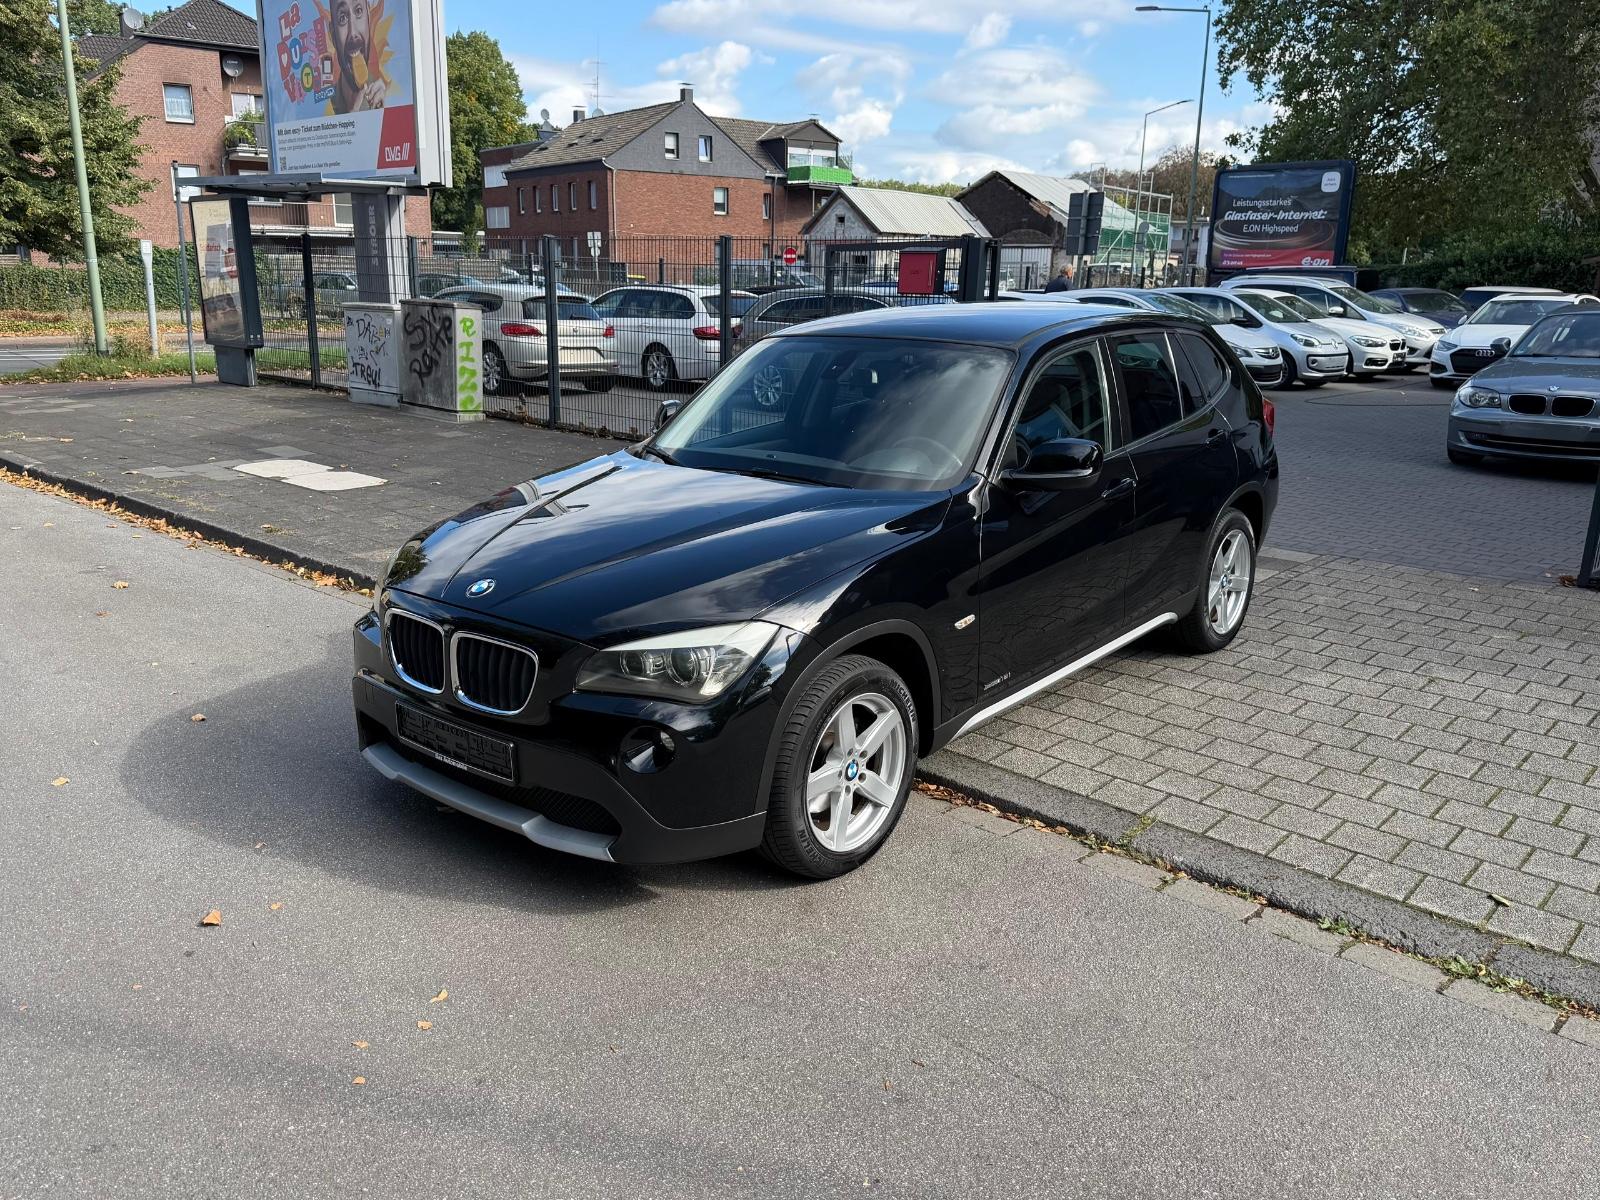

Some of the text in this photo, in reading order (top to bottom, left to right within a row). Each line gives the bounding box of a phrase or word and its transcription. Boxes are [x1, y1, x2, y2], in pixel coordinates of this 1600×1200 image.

[278, 1, 302, 41] La
[385, 145, 401, 162] DVG
[1232, 197, 1292, 208] Leistungsstarkes
[1242, 223, 1299, 235] E.ON Highspeed
